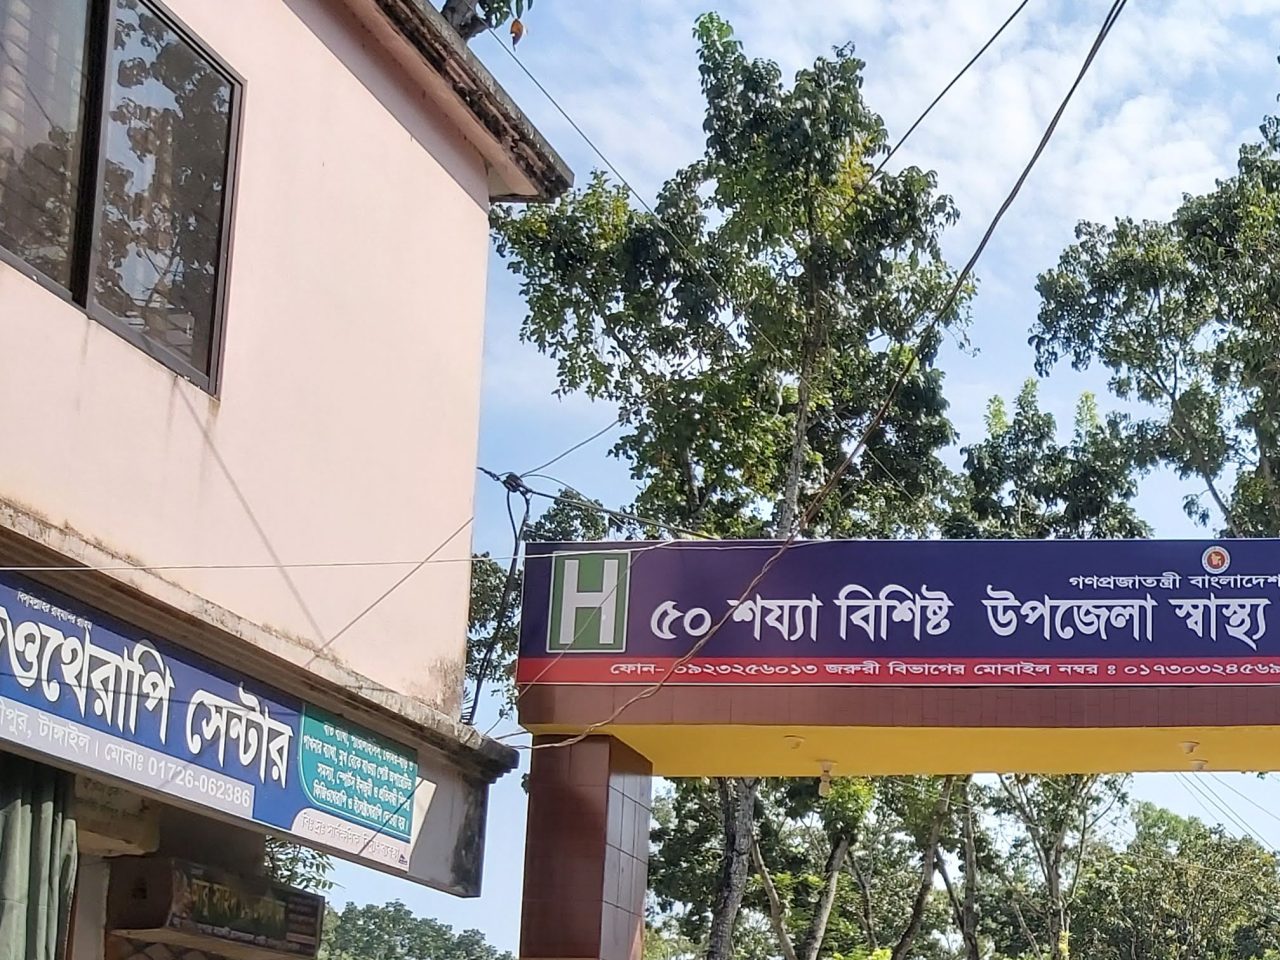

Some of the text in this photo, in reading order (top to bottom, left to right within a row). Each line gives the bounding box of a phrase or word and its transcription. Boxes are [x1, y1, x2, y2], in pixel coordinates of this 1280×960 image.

[559, 560, 618, 644] H
[1069, 571, 1182, 591] গণপ্রজাতন্ত্রী
[650, 600, 712, 640] ৫০
[726, 593, 824, 641] শয্যা
[833, 584, 955, 641] বিশিষ্ট
[981, 584, 1158, 641] উপজেলা
[1168, 592, 1272, 650] স্বাস্থ্য
[824, 660, 880, 675] জরুরী
[888, 660, 966, 675] বিভাগের
[973, 661, 1051, 676] মোবাইল
[1057, 664, 1099, 676] নম্বর
[186, 681, 294, 789] সেন্টার
[148, 759, 251, 808] 01726-062386
